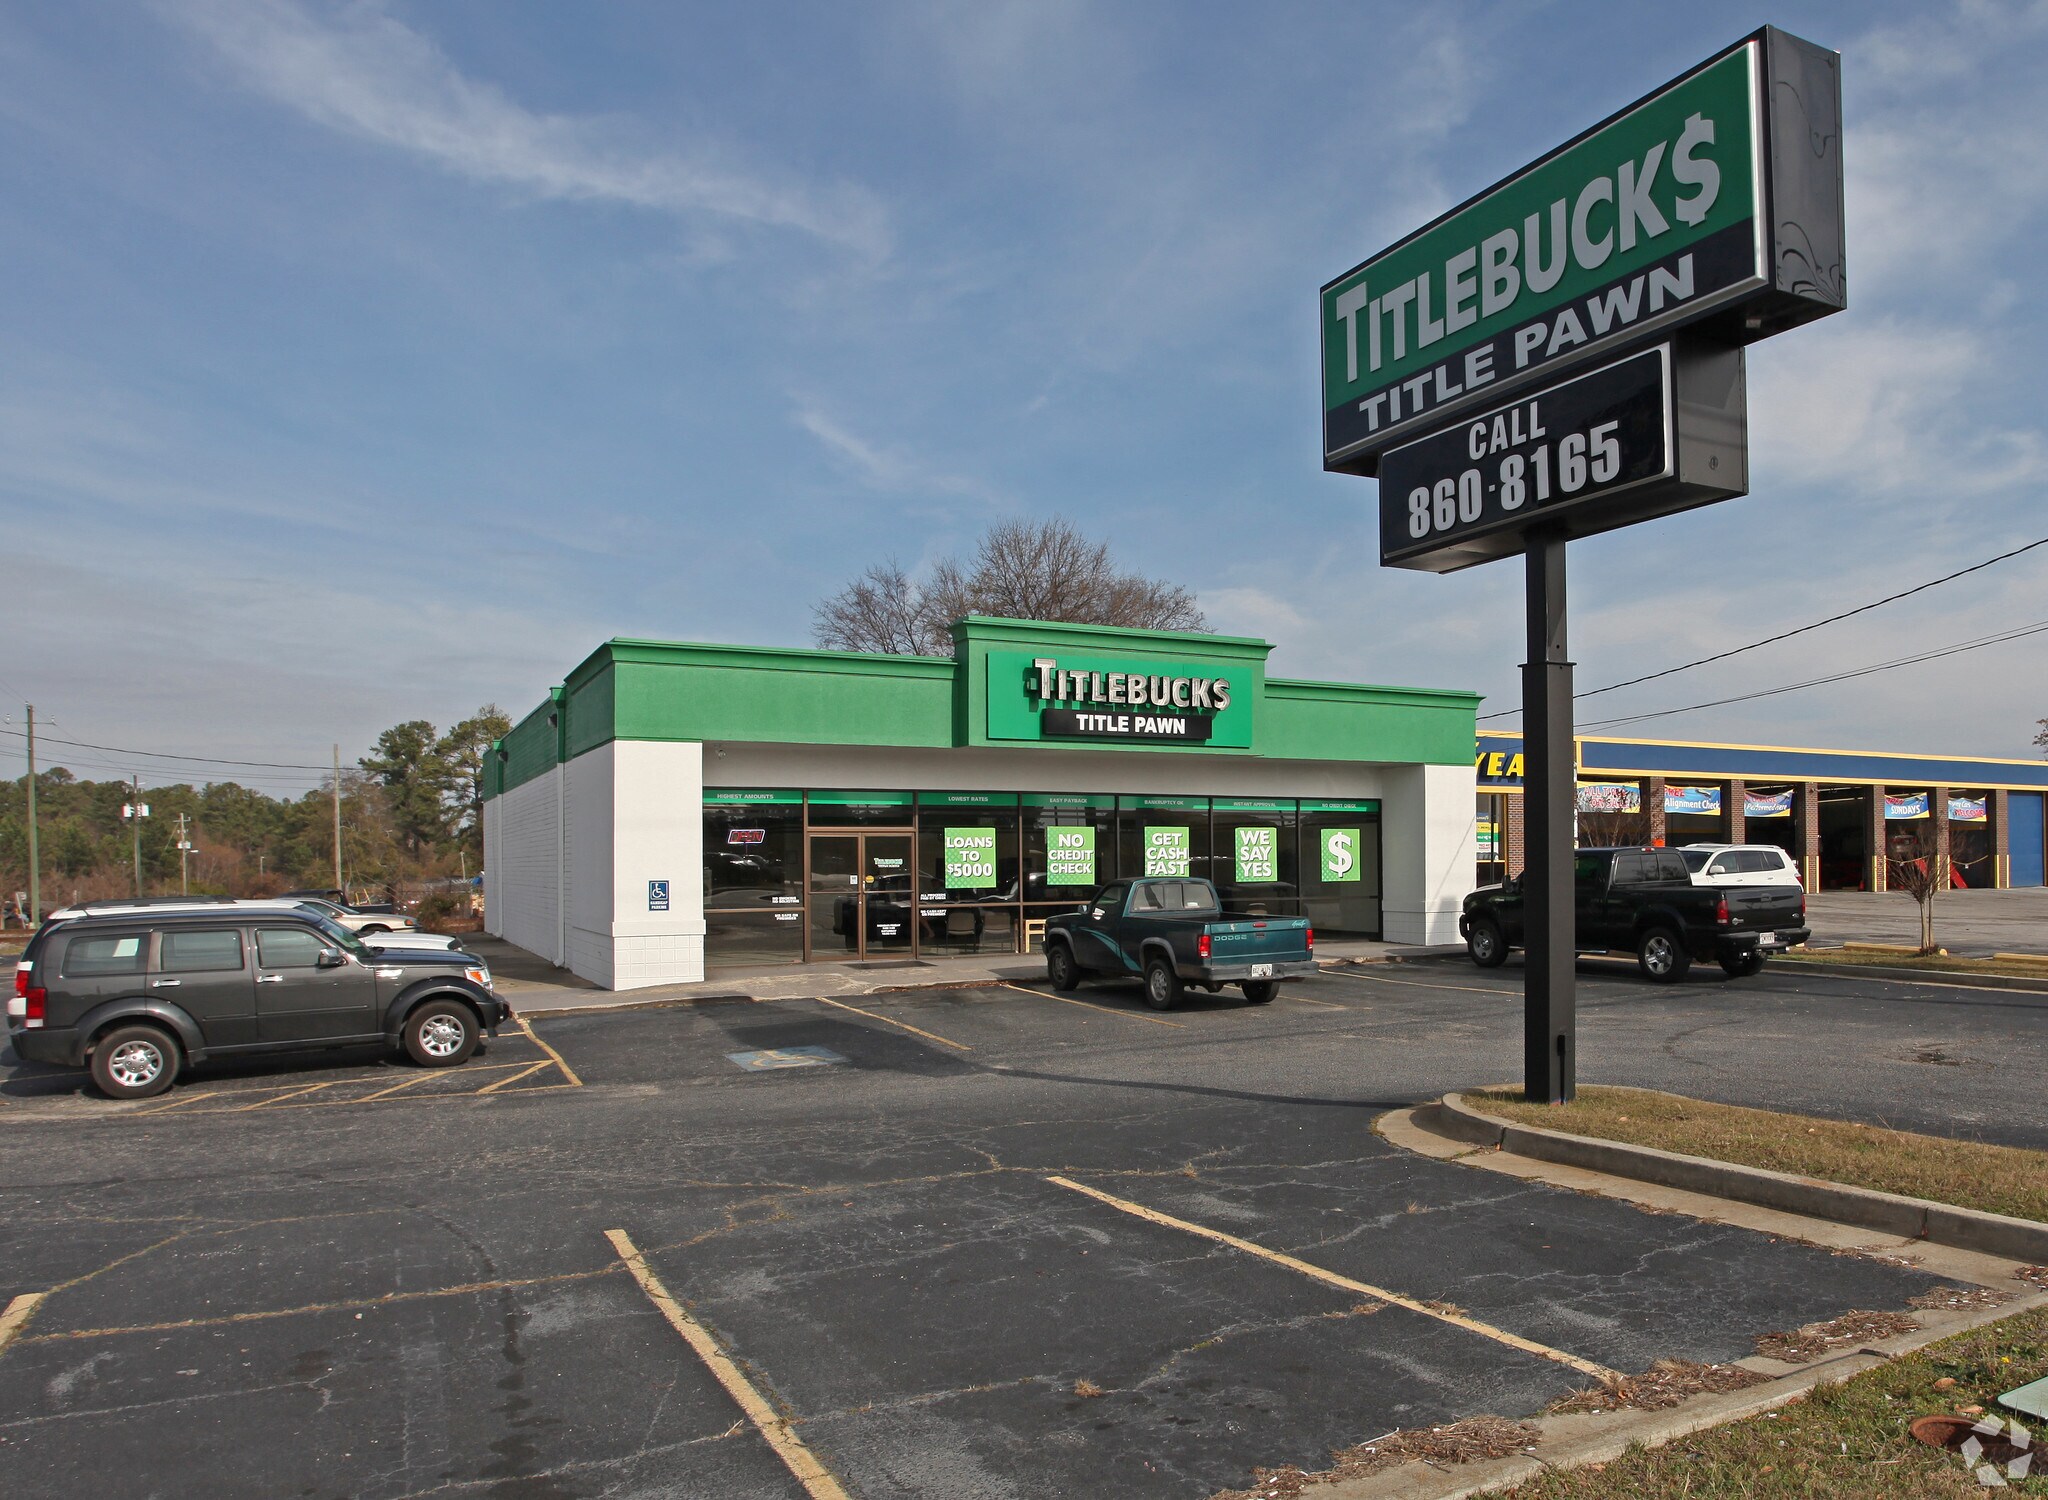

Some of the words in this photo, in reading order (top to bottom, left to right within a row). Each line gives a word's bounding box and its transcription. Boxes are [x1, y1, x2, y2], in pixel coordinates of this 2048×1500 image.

[1359, 343, 1495, 433] TITLE
[1514, 253, 1695, 370] PAWN
[1468, 401, 1546, 461] CALL
[1076, 713, 1130, 732] TITLE
[1134, 715, 1187, 734] PAWN
[1584, 786, 1601, 797] ALL
[1665, 798, 1702, 809] Alignment
[1702, 799, 1721, 810] Check
[1890, 804, 1921, 815] SUNDAYS
[730, 831, 764, 843] OPEN
[946, 836, 993, 848] LOANS
[1058, 833, 1084, 848] NO
[1151, 832, 1183, 846] GET
[1239, 830, 1270, 845] WE
[960, 850, 981, 862] TO
[1048, 849, 1094, 861] CREDIT
[1146, 847, 1188, 860] CASH
[1240, 846, 1272, 861] SAY
[1328, 831, 1353, 878] $
[947, 863, 993, 877] $5000
[1049, 862, 1092, 874] CHECK
[1146, 860, 1189, 875] FAST
[1240, 862, 1272, 877] YES
